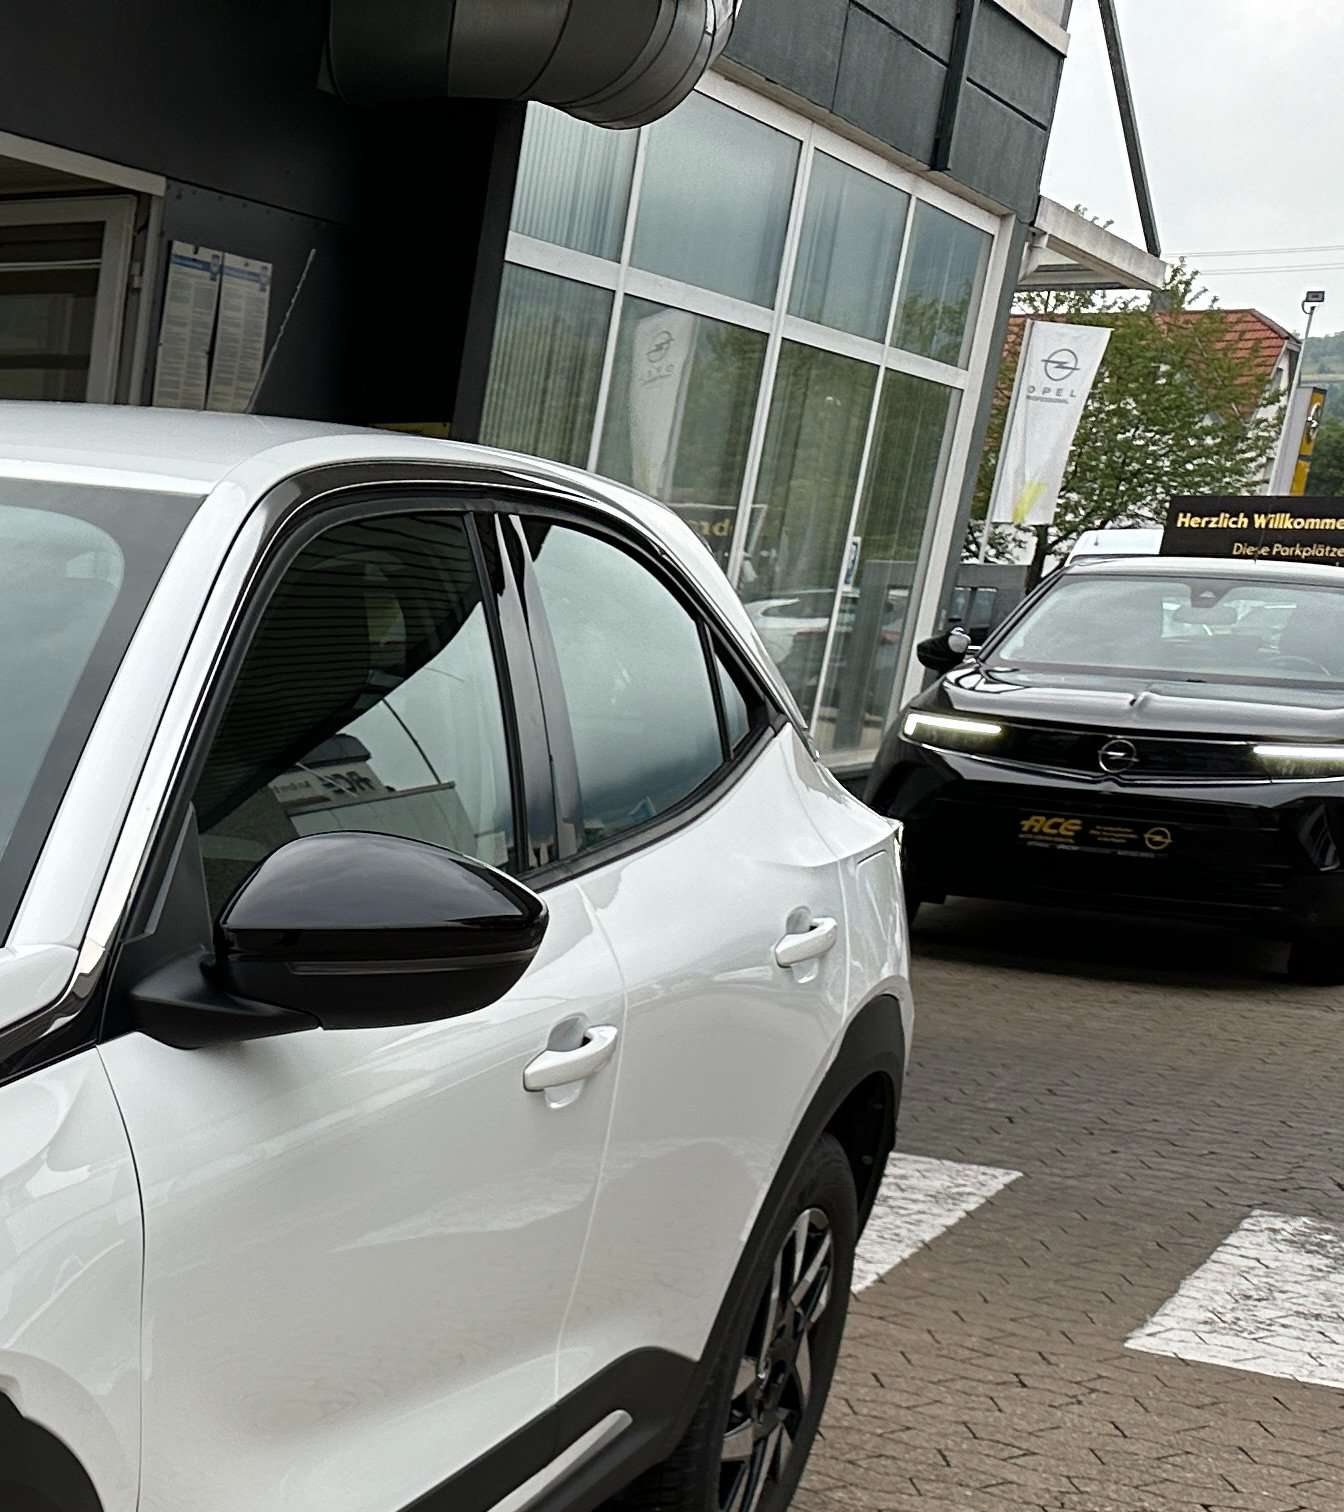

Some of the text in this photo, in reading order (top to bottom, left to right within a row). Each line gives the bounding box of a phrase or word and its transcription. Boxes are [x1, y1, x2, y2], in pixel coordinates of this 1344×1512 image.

[1026, 385, 1077, 398] OPEL
[1176, 512, 1249, 529] Herzlich
[1020, 815, 1083, 836] ACE
